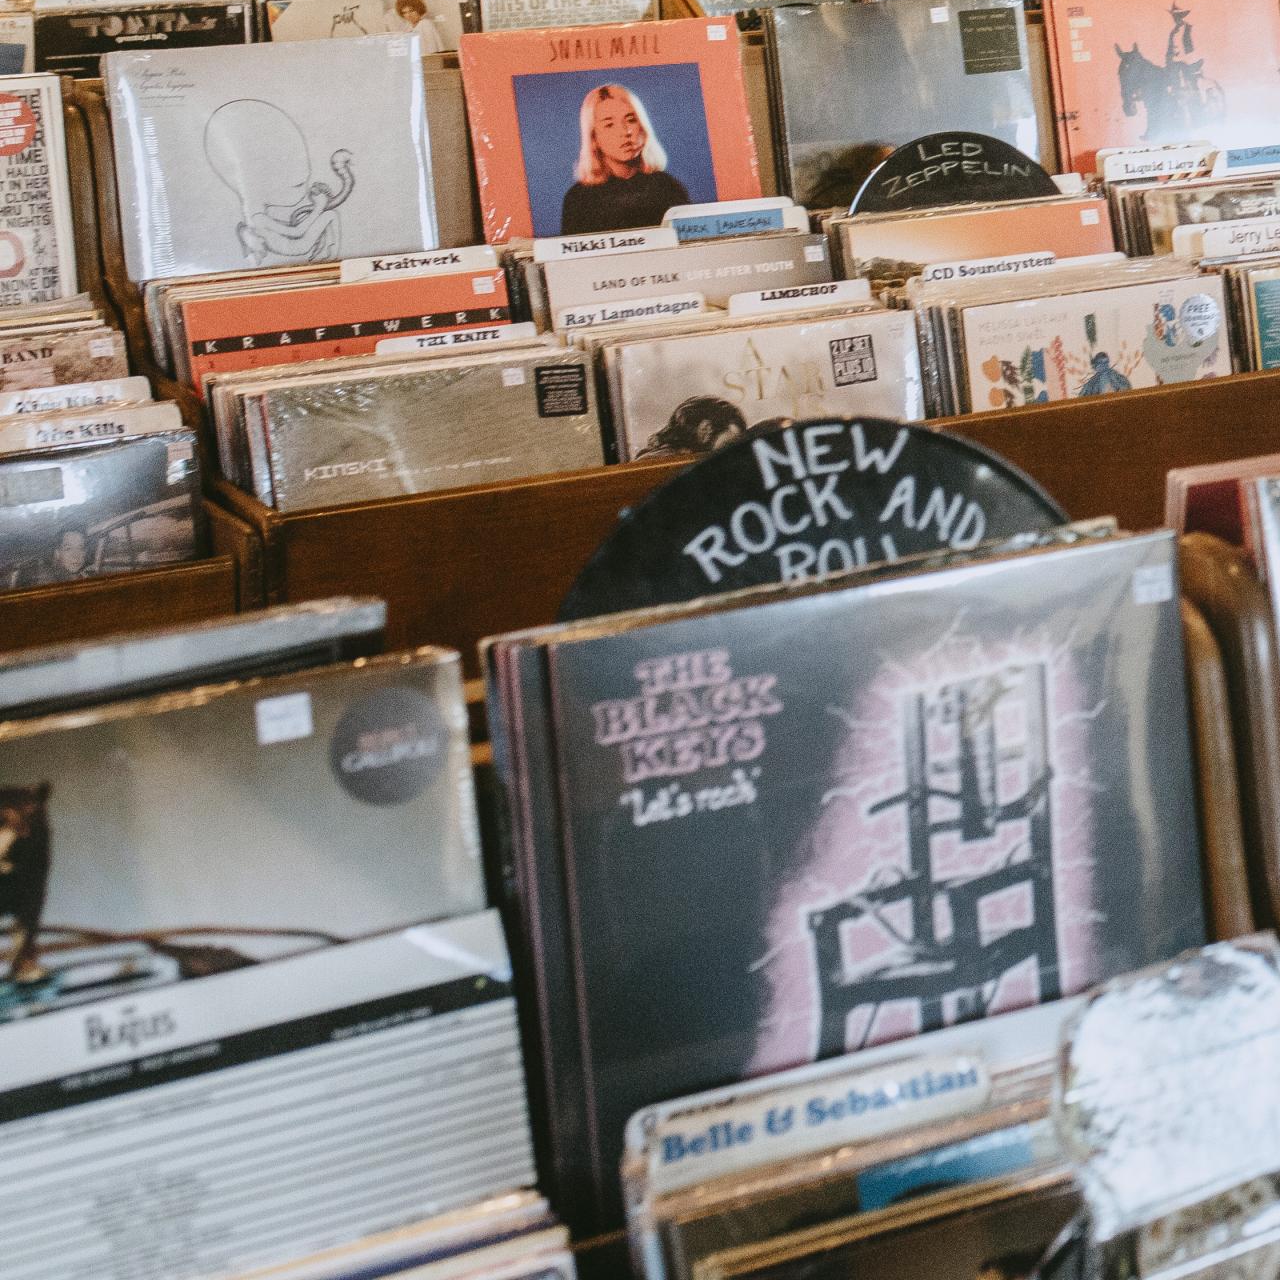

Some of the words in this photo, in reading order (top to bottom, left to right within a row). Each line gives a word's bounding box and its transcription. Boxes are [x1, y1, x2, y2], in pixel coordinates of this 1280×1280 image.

[550, 38, 602, 62] SNAIL
[609, 33, 661, 58] MAIL
[7, 149, 42, 165] TIME
[918, 141, 984, 159] LED
[25, 177, 50, 189] HER
[882, 159, 1032, 198] ZEPPELIN
[28, 202, 52, 214] THE
[6, 214, 51, 229] NIGHTS
[561, 239, 607, 255] Nikki
[610, 234, 646, 250] Lane
[1228, 227, 1262, 246] Jerry
[371, 252, 462, 272] Kraftwerk
[957, 254, 1057, 281] Soundsystem
[592, 277, 627, 292] LAND
[631, 275, 647, 288] OF
[650, 272, 680, 286] TALK
[686, 267, 711, 281] LIFE
[715, 264, 752, 278] AFTER
[754, 259, 794, 273] YOUTH
[760, 282, 839, 302] LAMBCHOP
[564, 312, 597, 328] Ray
[601, 297, 700, 322] Lamontagne
[204, 308, 502, 354] KRAFTWERK
[452, 328, 501, 345] KNIFE
[2, 346, 55, 365] BAND
[739, 336, 764, 370] A
[77, 420, 126, 440] Kills
[752, 421, 911, 491] NEW
[684, 475, 853, 583] ROCK
[880, 475, 986, 552] AND
[592, 674, 785, 745] BLACK
[660, 1120, 755, 1164] Belle
[763, 1104, 796, 1136] &
[803, 1063, 981, 1127] Sebastian
